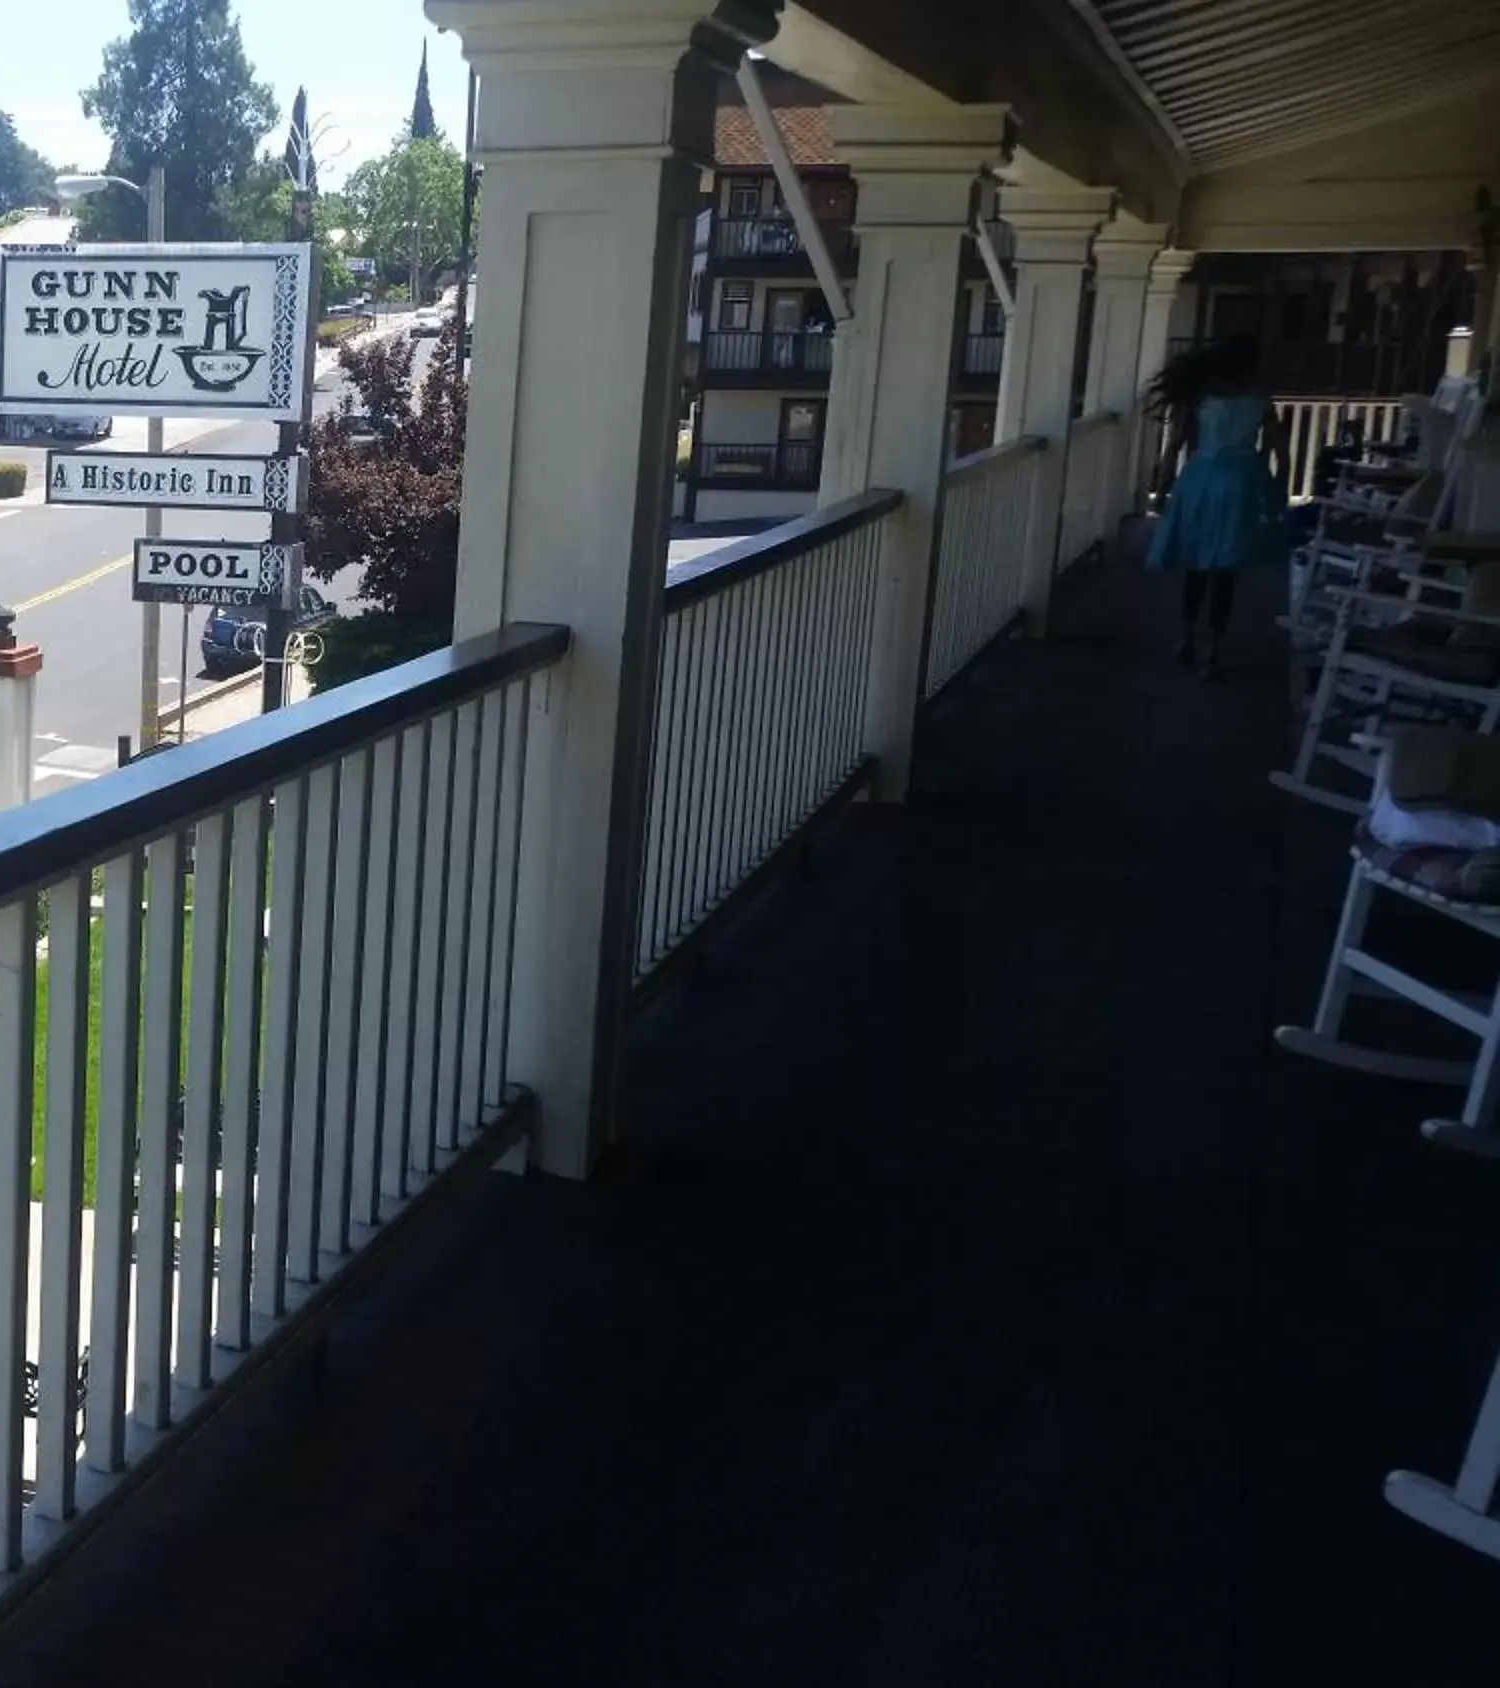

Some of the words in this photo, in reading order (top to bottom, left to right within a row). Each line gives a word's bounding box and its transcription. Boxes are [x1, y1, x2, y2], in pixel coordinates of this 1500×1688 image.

[31, 270, 180, 301] GUNN
[24, 306, 186, 338] HOUSE
[37, 341, 169, 392] Motel
[52, 463, 68, 490] A
[81, 465, 194, 495] Historic
[206, 469, 253, 496] Inn
[148, 551, 249, 579] POOL
[176, 586, 256, 606] VACANCY
